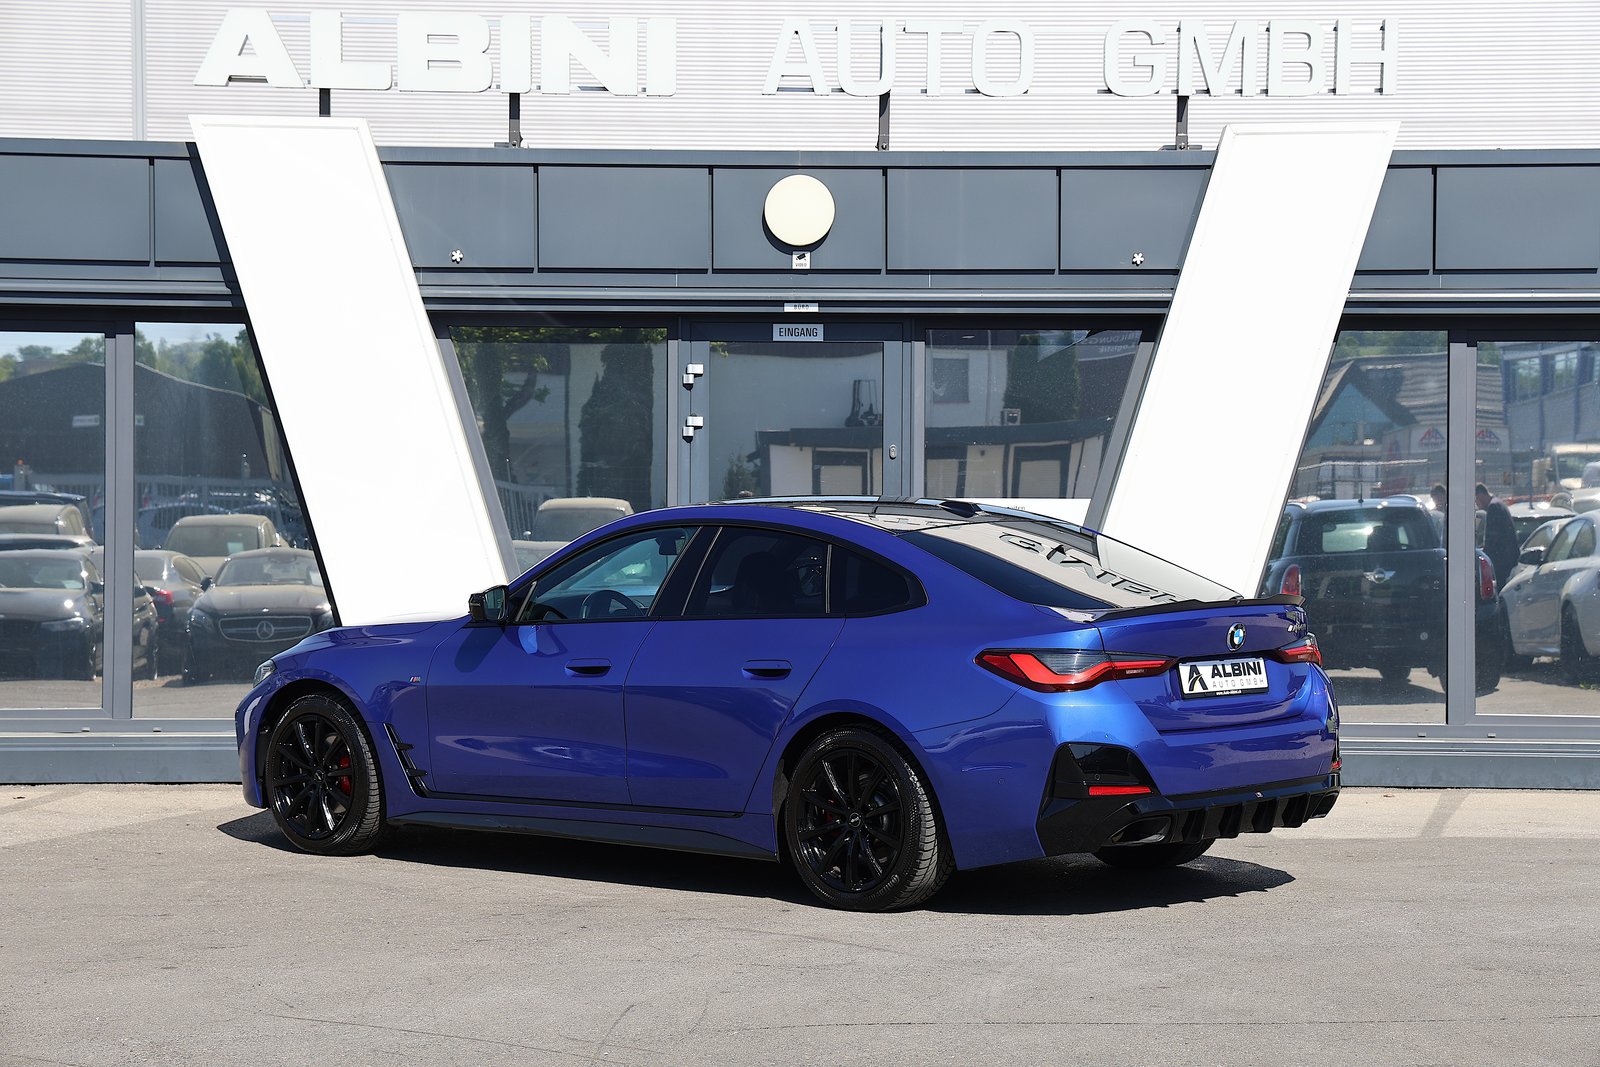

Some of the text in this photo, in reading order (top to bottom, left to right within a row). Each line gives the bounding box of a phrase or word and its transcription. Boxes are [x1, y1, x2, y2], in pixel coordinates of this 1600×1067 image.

[193, 8, 1399, 97] ALBINI AUTO GMBH
[778, 327, 818, 337] EINGANG
[1211, 661, 1262, 678] ALBINI
[1212, 677, 1265, 688] AUTO GMBH
